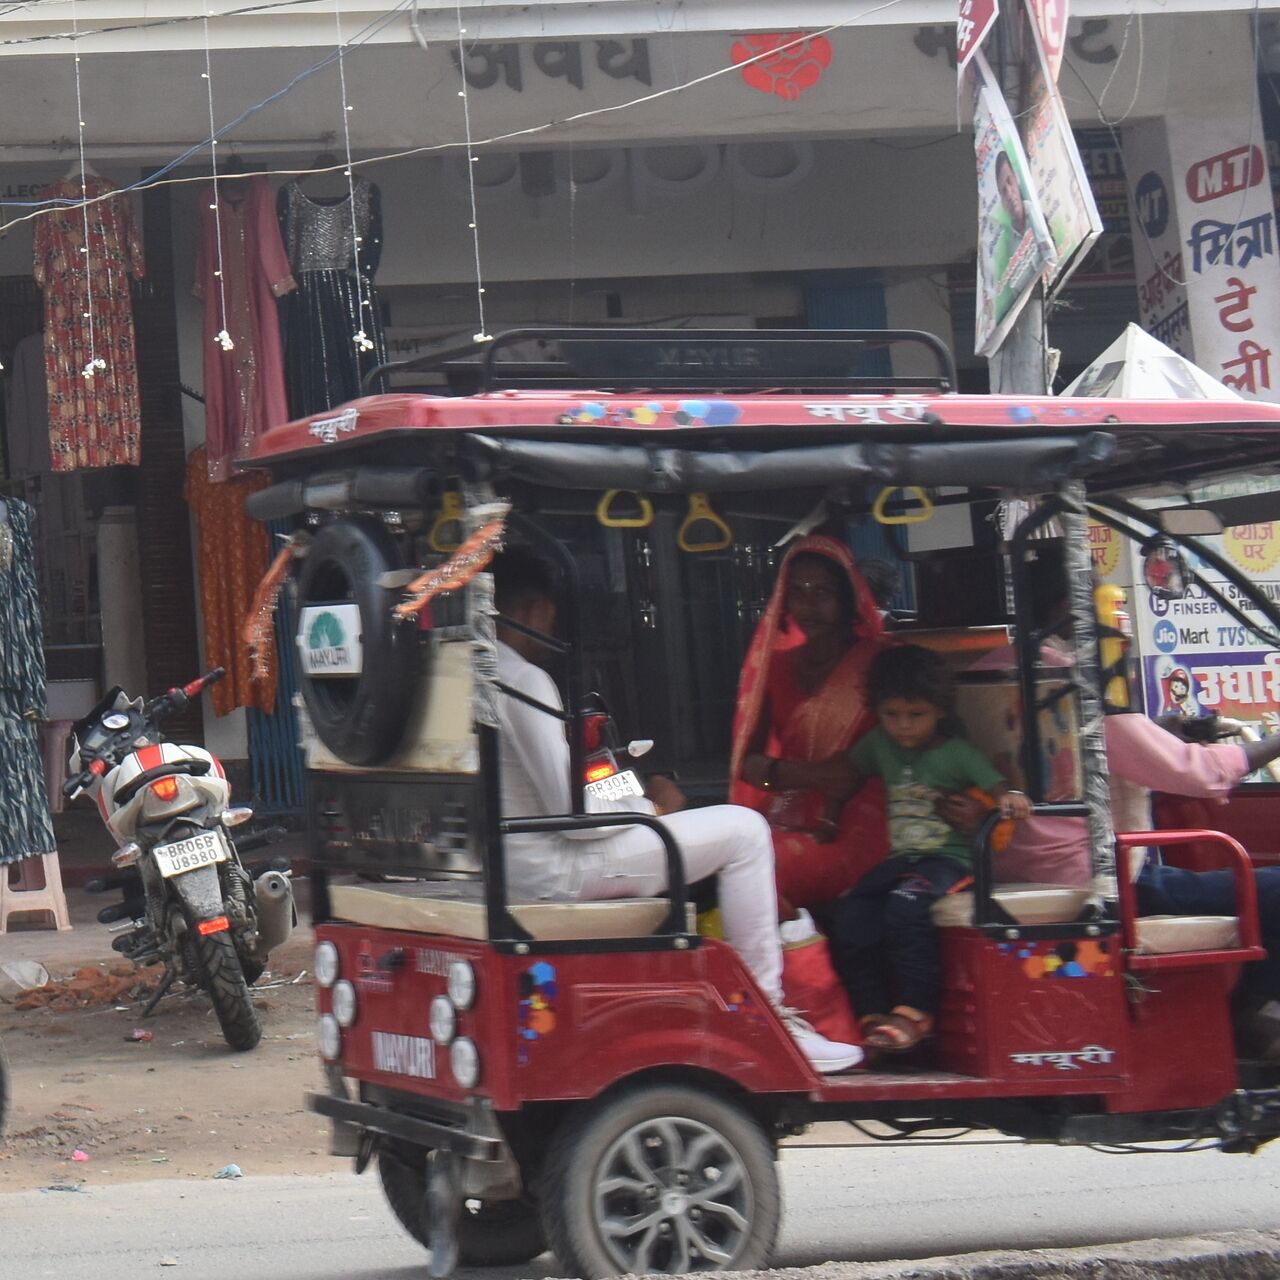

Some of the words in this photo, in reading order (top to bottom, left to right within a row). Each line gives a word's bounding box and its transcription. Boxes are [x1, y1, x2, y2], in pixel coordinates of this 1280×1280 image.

[1186, 212, 1273, 274] मित्रा
[803, 399, 929, 425] मयूरी
[1243, 543, 1266, 561] पर
[1155, 627, 1176, 645] Jio
[1179, 627, 1210, 644] Mart
[587, 775, 630, 797] BR30A
[1008, 1045, 1116, 1071] मयूरी
